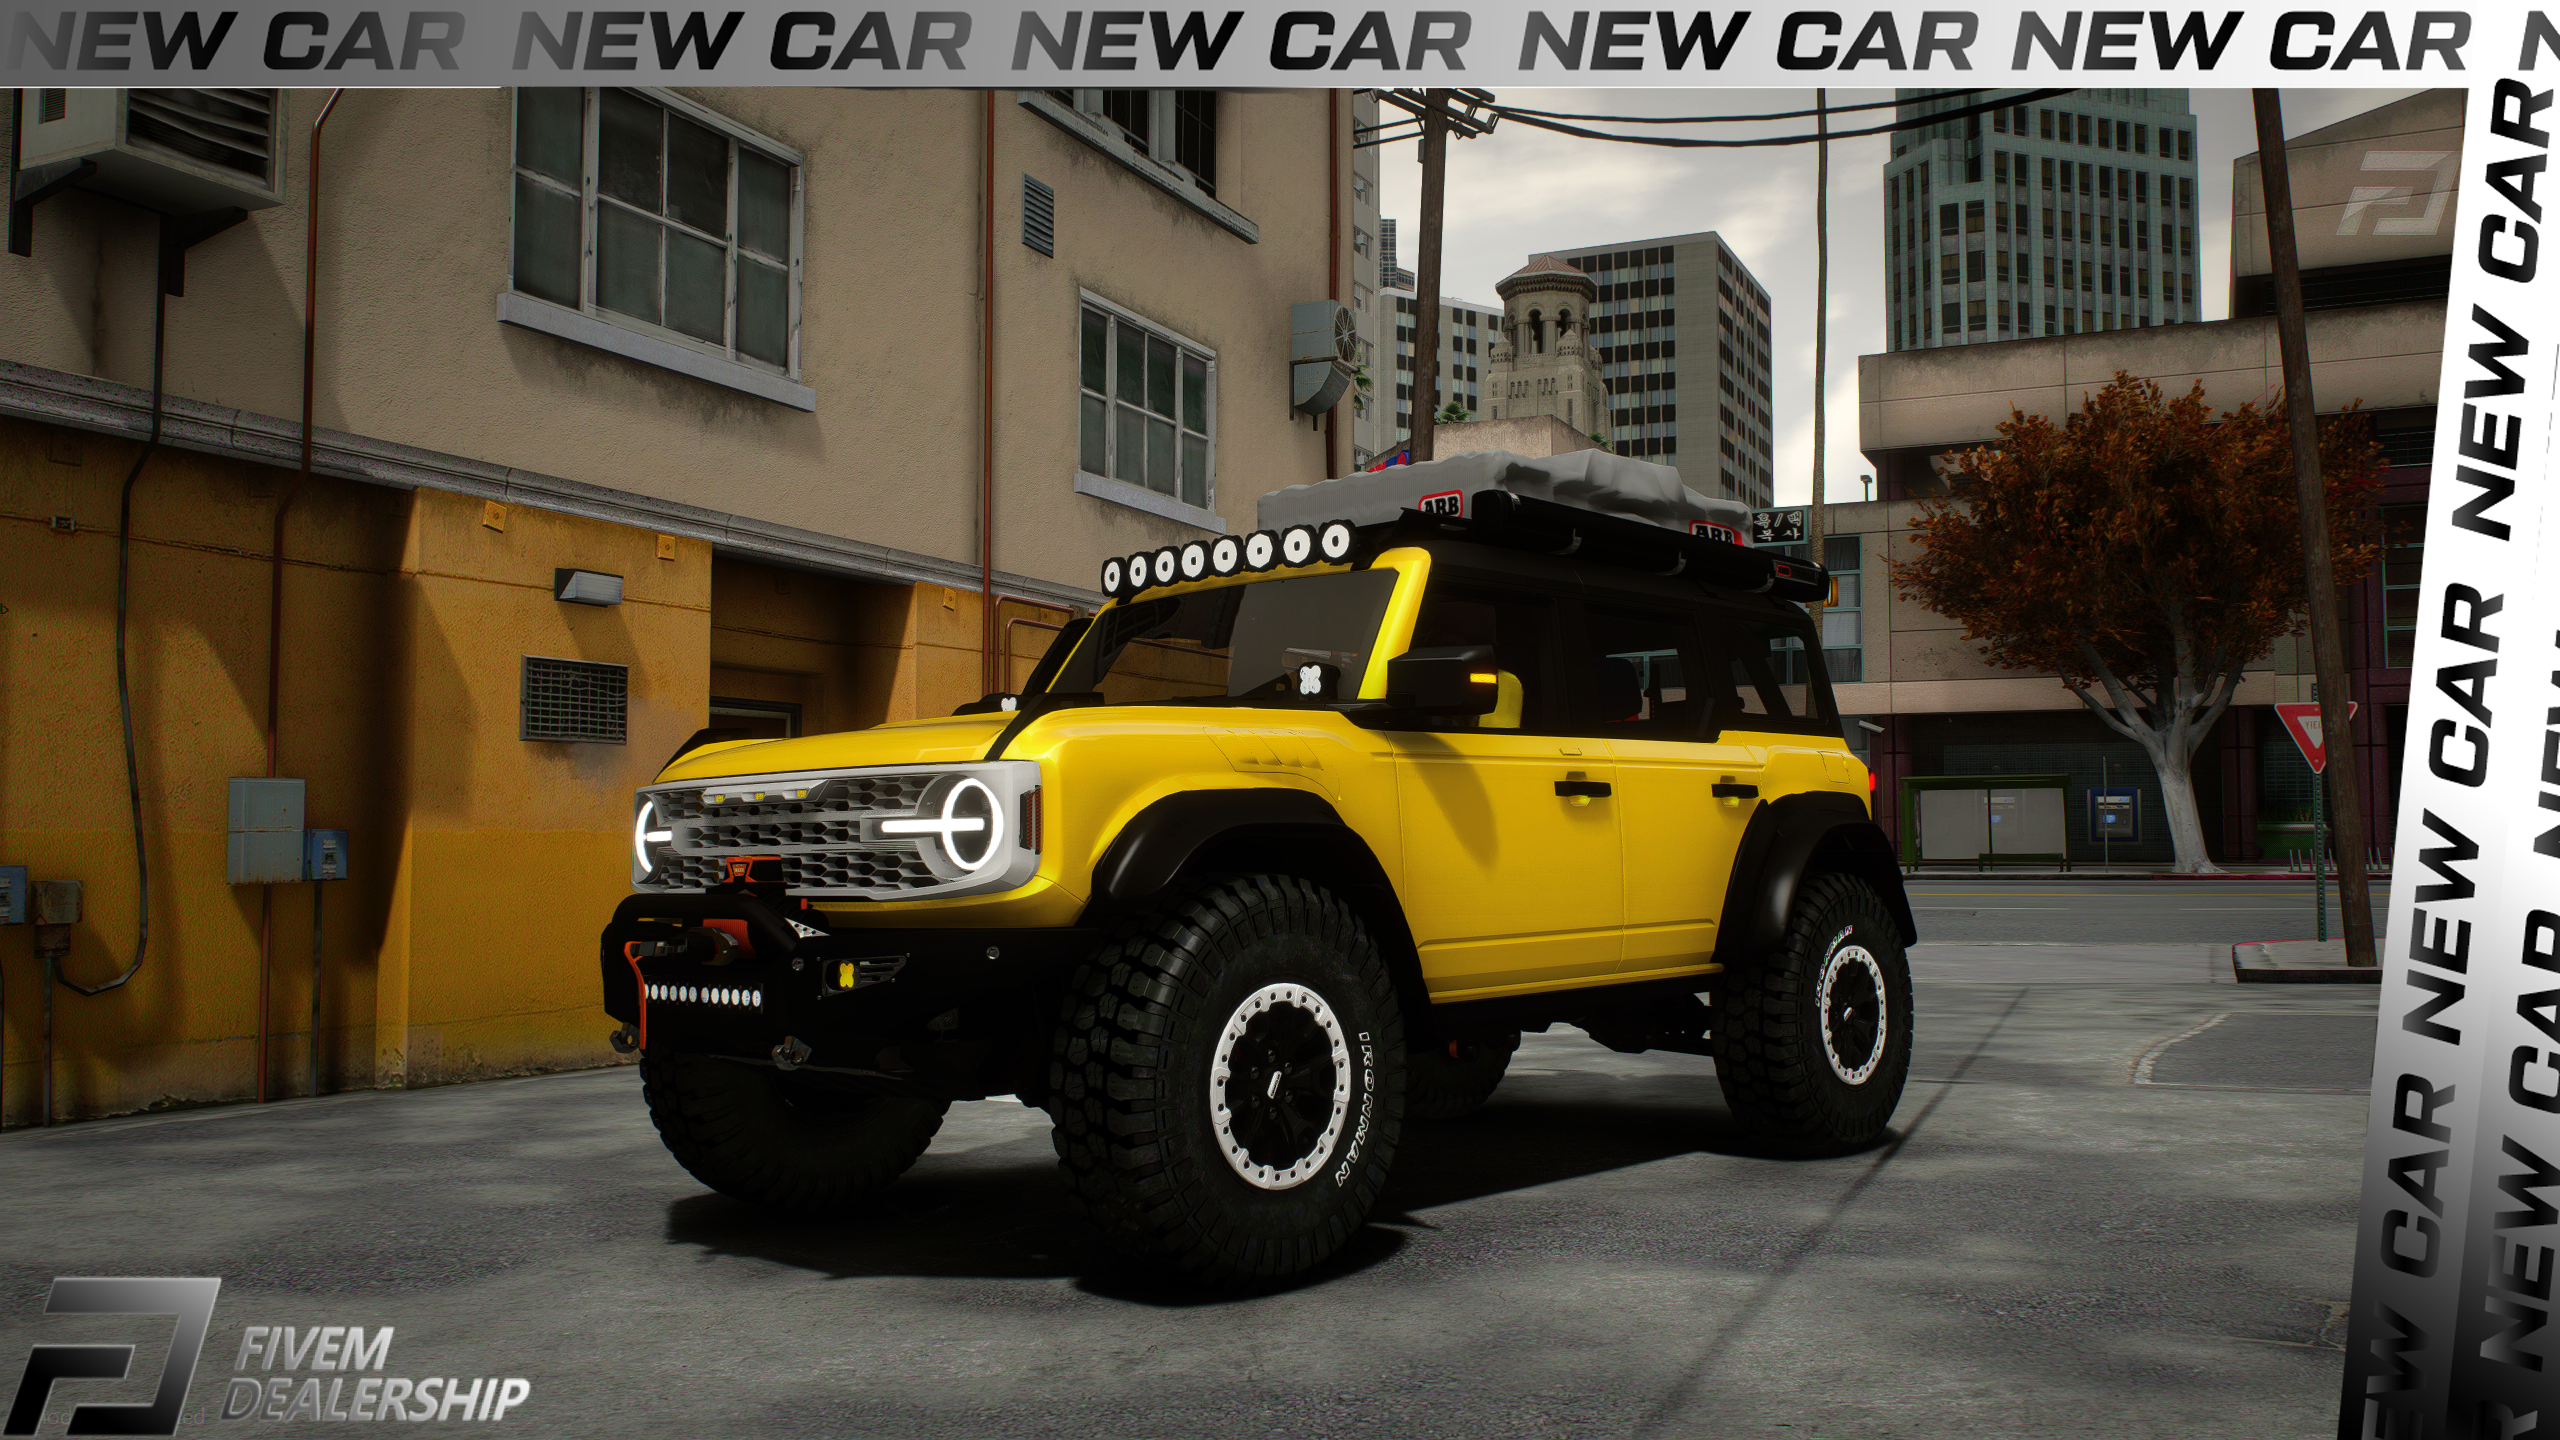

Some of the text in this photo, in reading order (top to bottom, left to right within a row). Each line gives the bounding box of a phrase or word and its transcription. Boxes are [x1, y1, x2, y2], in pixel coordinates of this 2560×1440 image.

[1424, 495, 1460, 517] ARB
[2305, 720, 2323, 730] YIEL
[1336, 1031, 1376, 1188] IRONMAN
